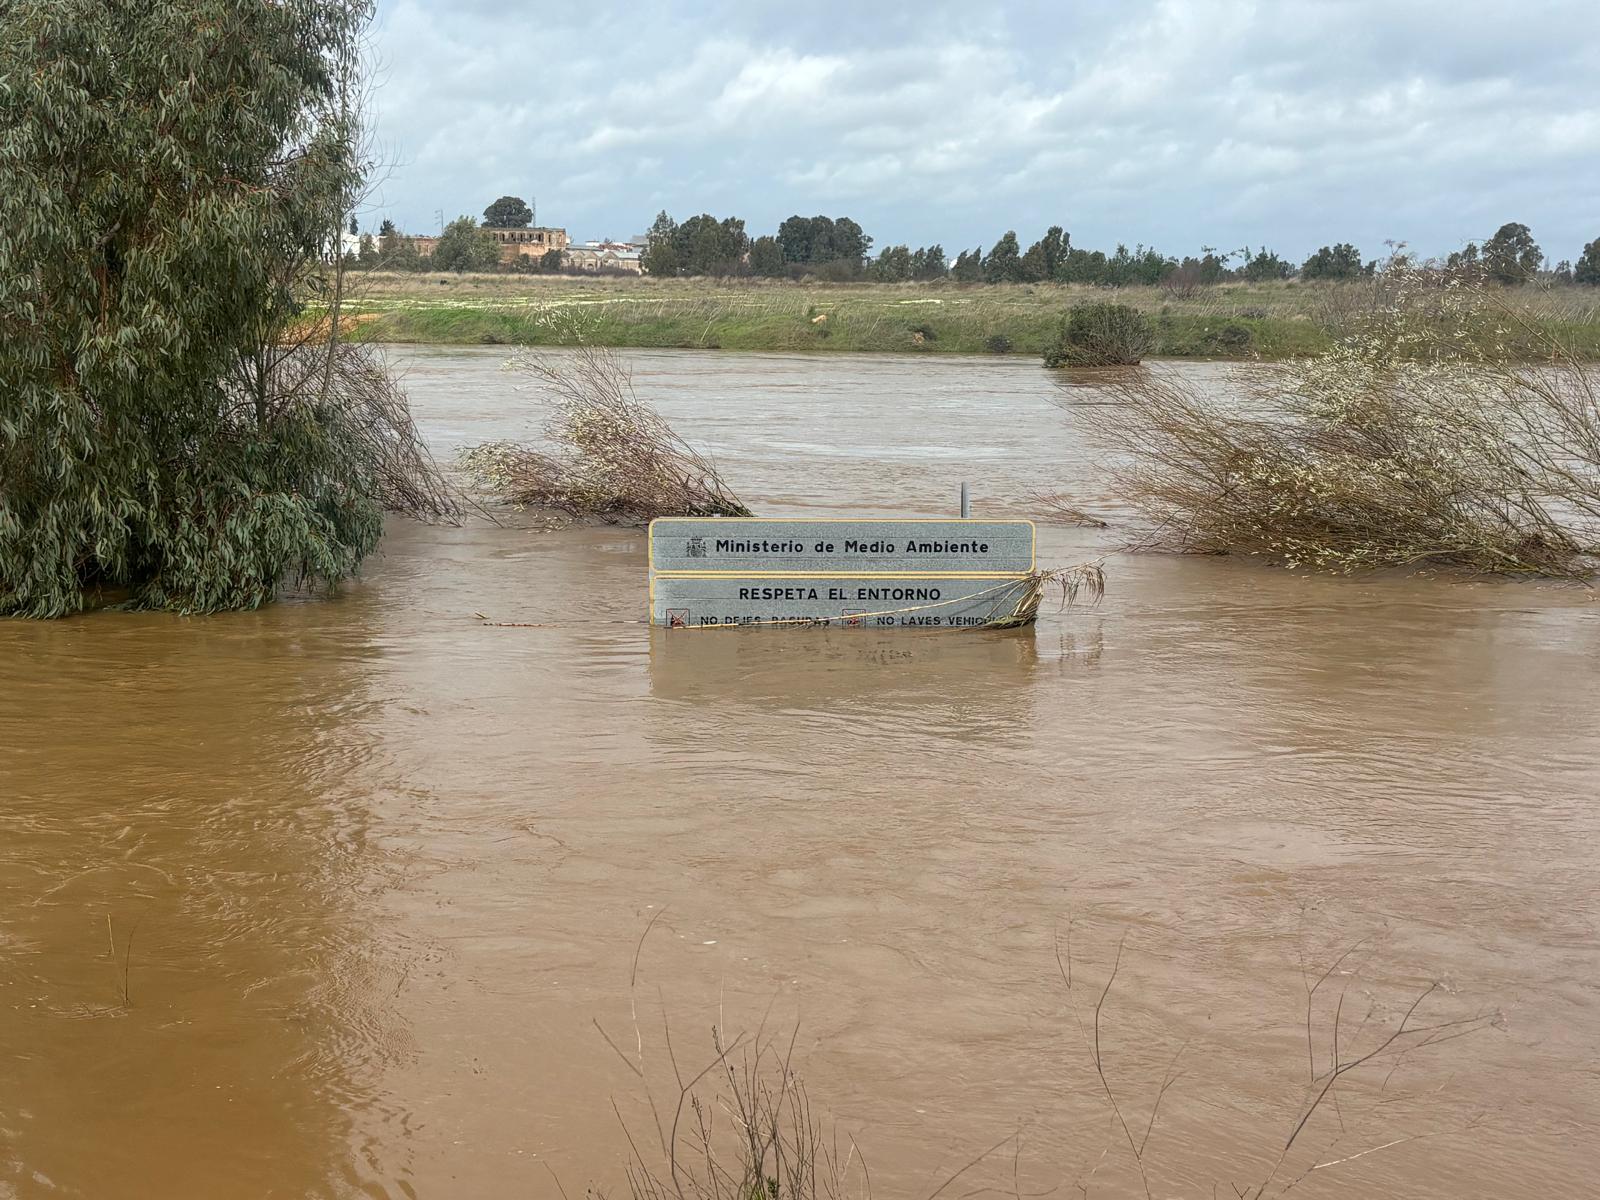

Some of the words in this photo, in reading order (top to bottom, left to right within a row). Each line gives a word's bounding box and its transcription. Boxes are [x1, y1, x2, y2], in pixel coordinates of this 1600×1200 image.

[716, 540, 804, 553] Ministerio
[814, 540, 835, 553] de
[845, 540, 895, 553] Medio
[905, 540, 989, 553] Ambiente
[739, 588, 818, 600] RESPETA
[829, 588, 848, 600] EL
[857, 588, 941, 600] ENTORNO
[700, 616, 718, 626] NO
[876, 616, 895, 626] NO
[901, 616, 941, 626] LAVES
